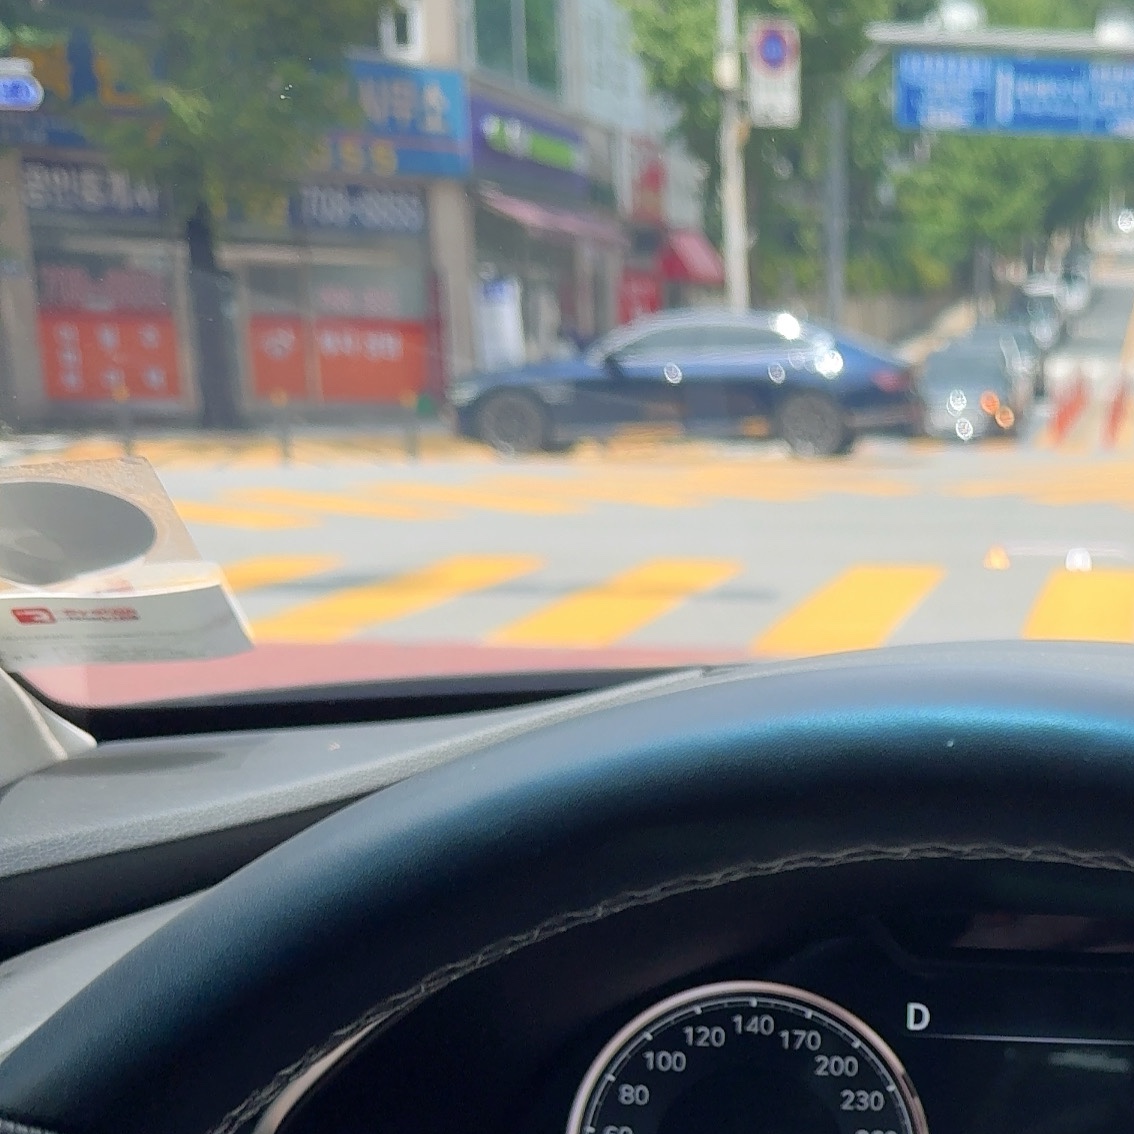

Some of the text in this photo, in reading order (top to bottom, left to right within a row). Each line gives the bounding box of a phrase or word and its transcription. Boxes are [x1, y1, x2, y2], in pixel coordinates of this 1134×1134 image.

[732, 1014, 775, 1037] 140
[906, 1002, 931, 1031] D
[683, 1025, 726, 1048] 120
[780, 1029, 822, 1052] 170
[643, 1050, 687, 1073] 100
[814, 1054, 859, 1077] 200
[618, 1083, 650, 1106] 80
[840, 1089, 886, 1112] 230
